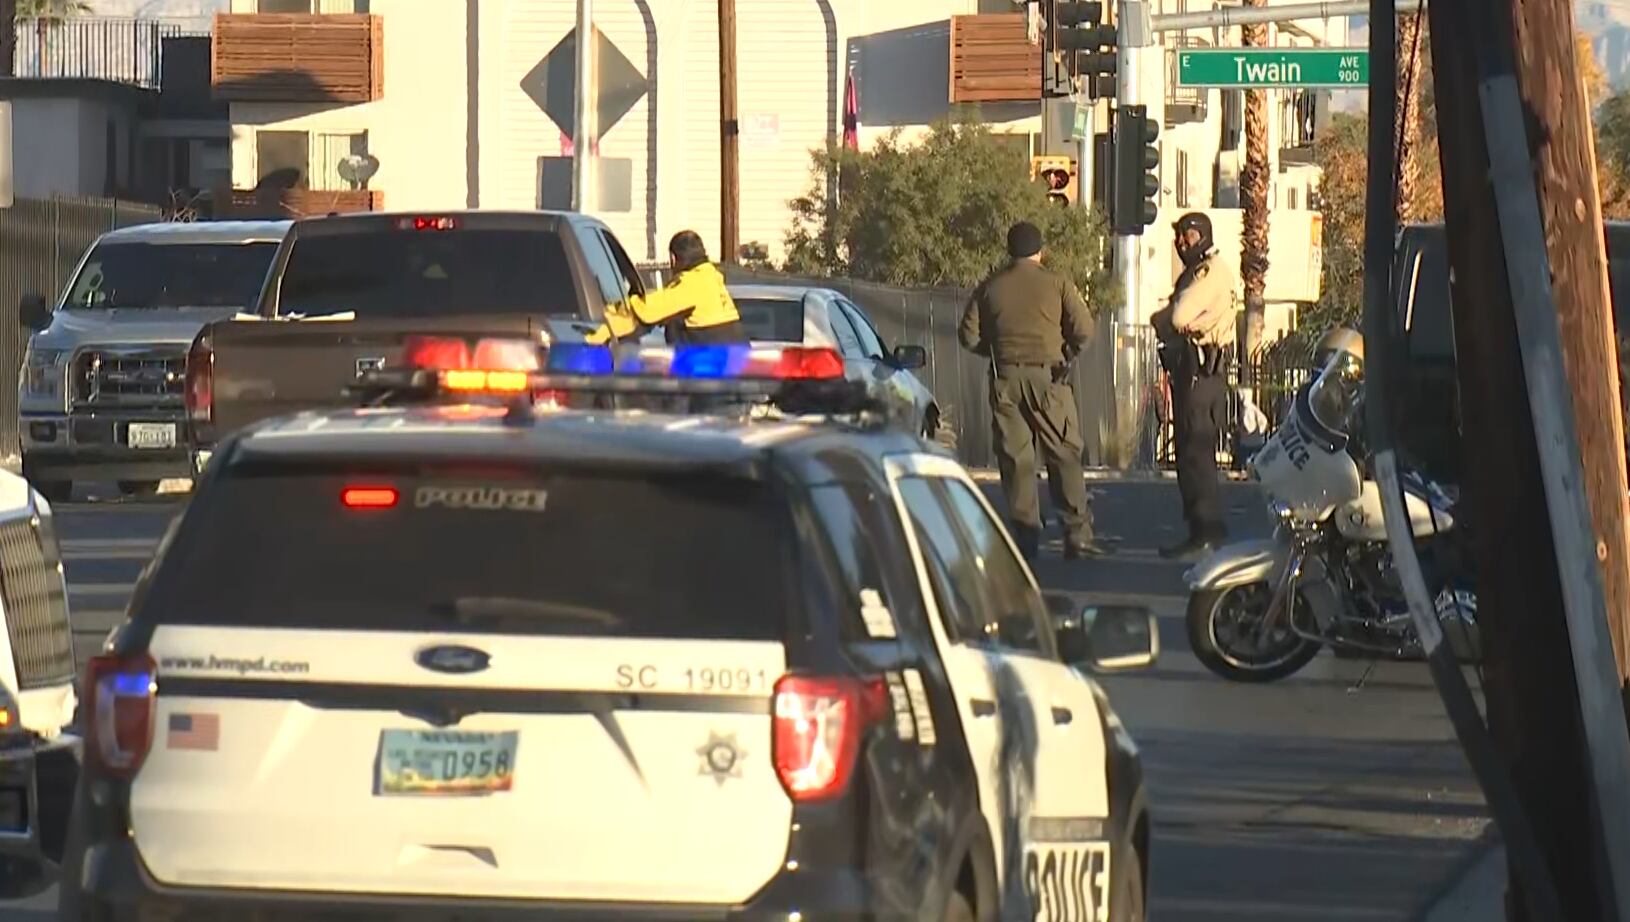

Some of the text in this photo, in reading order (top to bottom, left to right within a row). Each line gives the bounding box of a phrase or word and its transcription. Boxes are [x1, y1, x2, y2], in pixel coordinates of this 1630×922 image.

[1182, 55, 1360, 82] E Twain AVE
[1338, 70, 1360, 82] 900
[414, 486, 547, 512] POLICE
[160, 654, 310, 675] www.lvmpd.com
[616, 664, 767, 691] SC 19091
